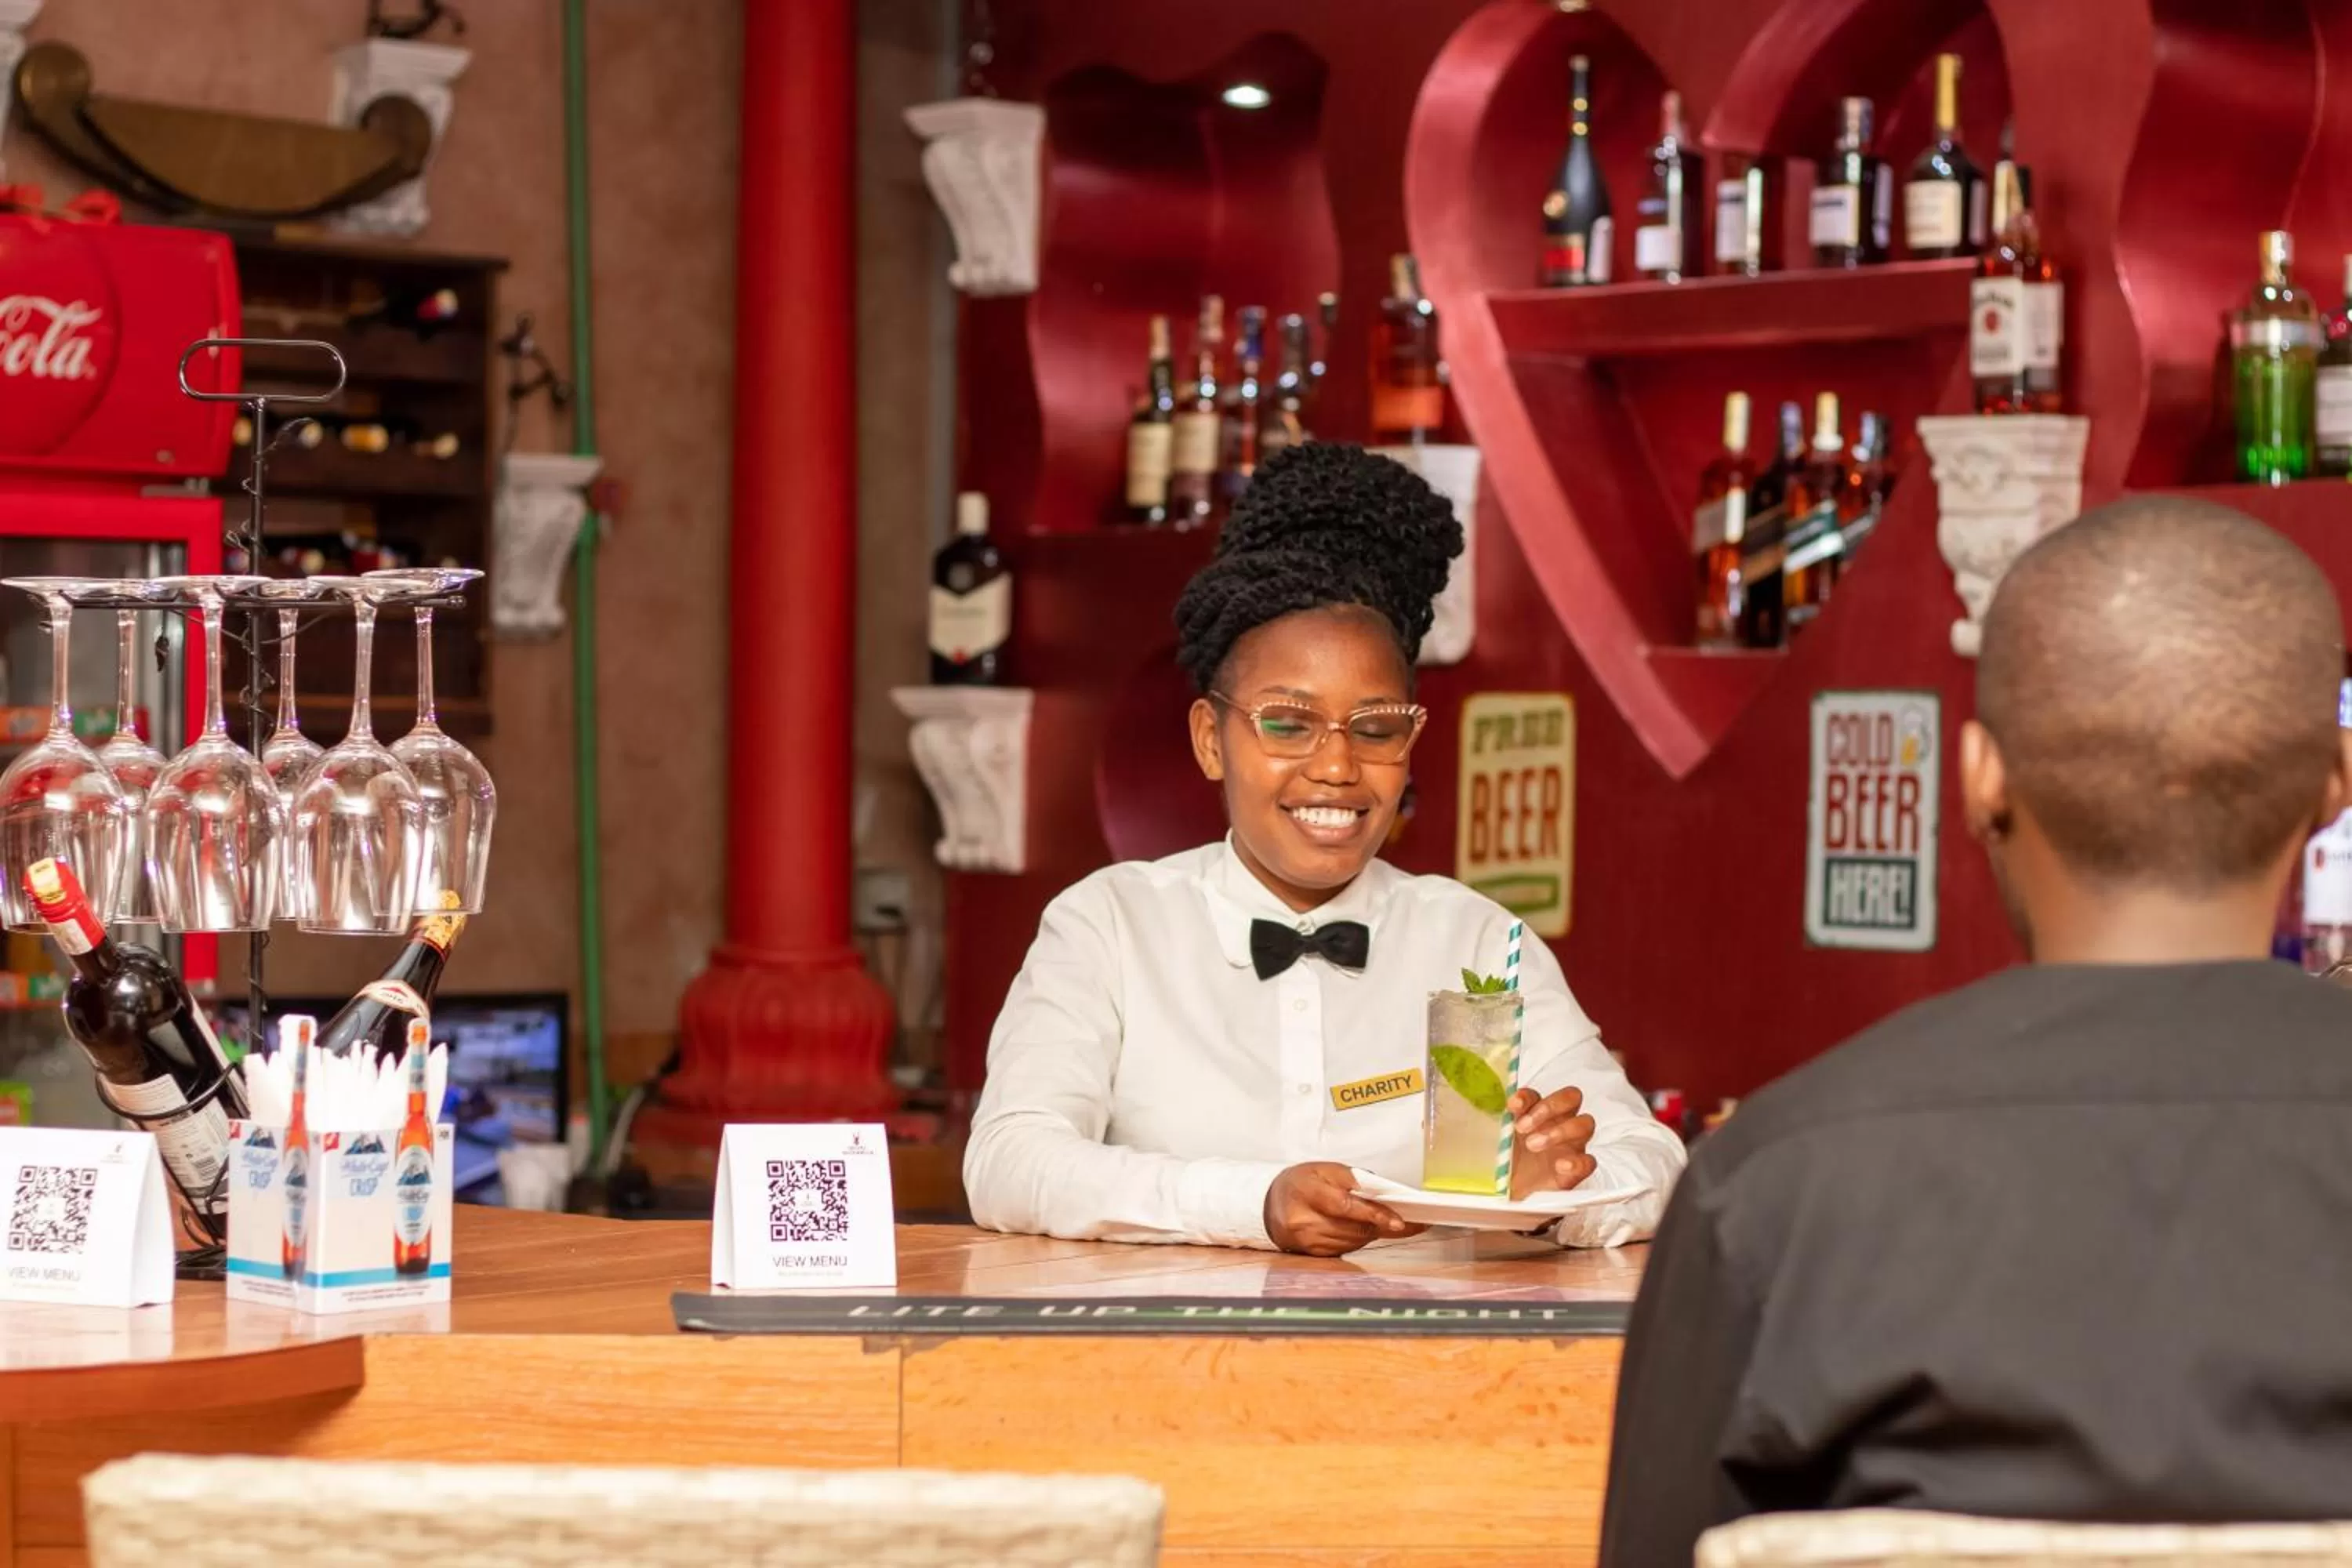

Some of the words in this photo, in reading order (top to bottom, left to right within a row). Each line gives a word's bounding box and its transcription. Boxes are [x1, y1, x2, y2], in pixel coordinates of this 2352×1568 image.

[1826, 713, 1893, 766] COLD
[1469, 765, 1561, 865] BEER
[1824, 772, 1921, 852] BEER
[1340, 1075, 1411, 1102] CHARITY
[6, 1265, 39, 1279] VIEW
[42, 1268, 82, 1282] MENU
[772, 1256, 807, 1267] VIEW
[810, 1256, 848, 1267] MENU
[848, 1305, 1004, 1317] LITE
[1039, 1305, 1137, 1317] UP
[1174, 1305, 1309, 1318] THE
[1348, 1307, 1567, 1320] NIGHT
